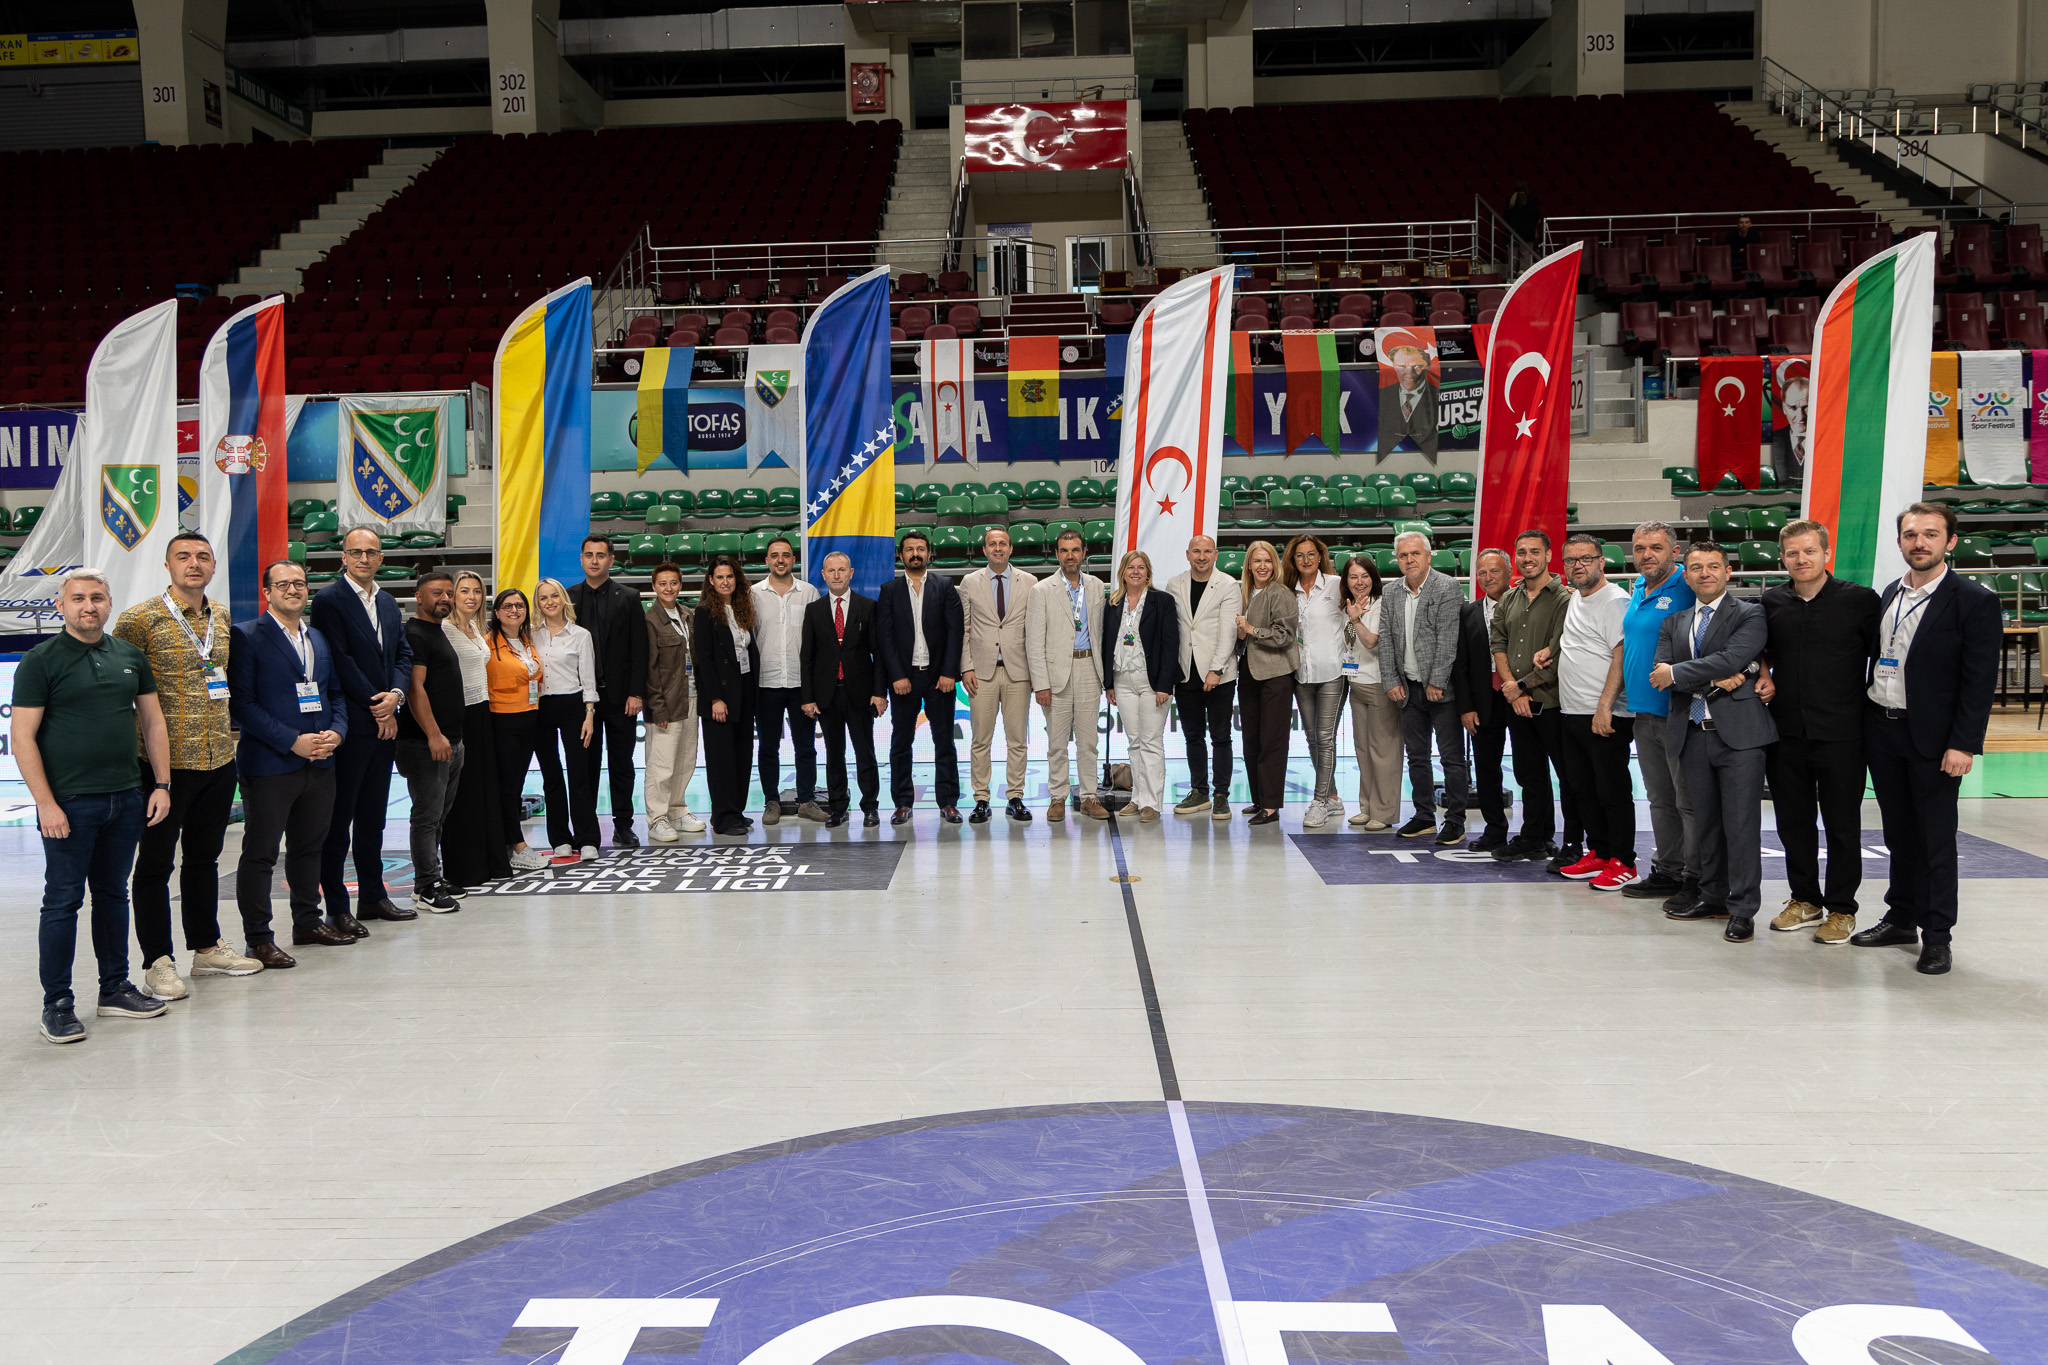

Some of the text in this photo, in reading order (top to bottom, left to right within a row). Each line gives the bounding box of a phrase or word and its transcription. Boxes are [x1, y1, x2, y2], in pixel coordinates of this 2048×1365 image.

[1586, 34, 1615, 52] 303
[499, 73, 526, 91] 302
[152, 86, 176, 103] 301
[240, 75, 266, 107] FURKAN
[502, 96, 526, 113] 201
[1438, 389, 1468, 402] KETBOL
[688, 412, 741, 436] TOFAŞ
[1971, 423, 1988, 431] Spor
[1093, 460, 1116, 473] 102
